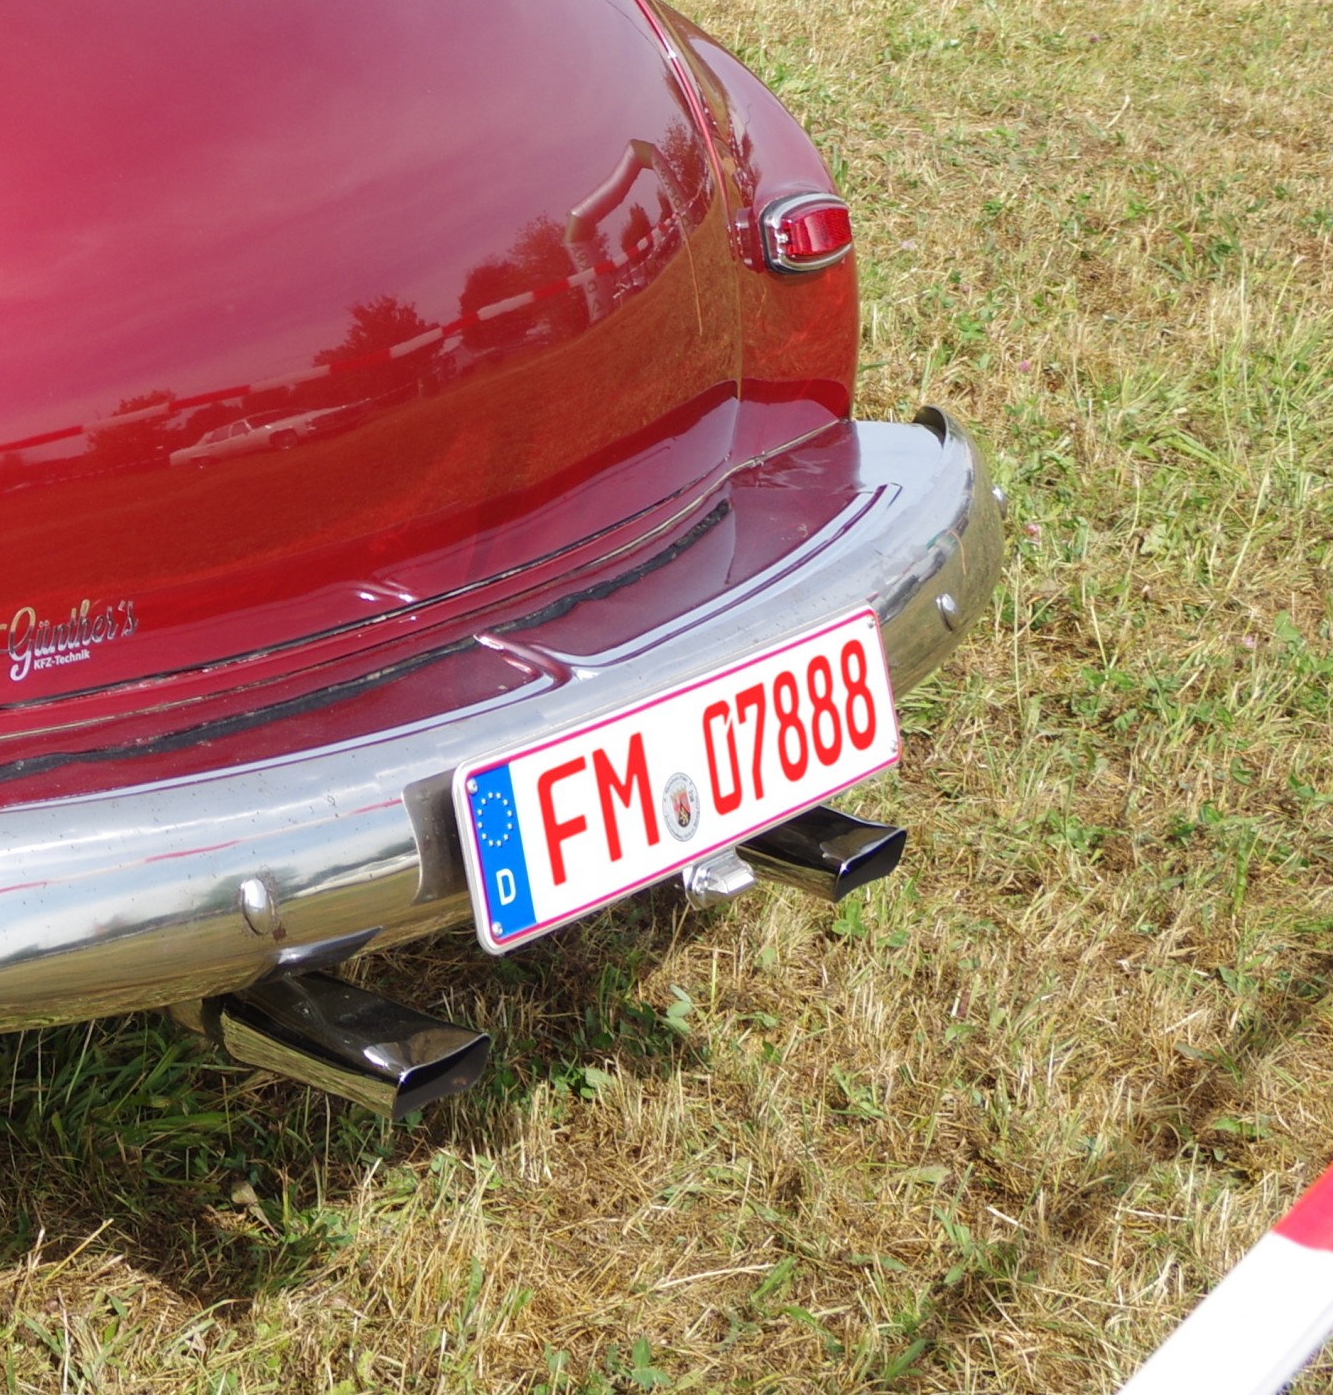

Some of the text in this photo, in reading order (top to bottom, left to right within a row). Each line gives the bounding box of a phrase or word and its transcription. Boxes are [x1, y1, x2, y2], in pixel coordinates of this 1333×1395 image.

[33, 649, 91, 671] KFZ-Technik
[537, 731, 660, 886] FM
[702, 639, 877, 816] 07888
[495, 868, 517, 906] D
